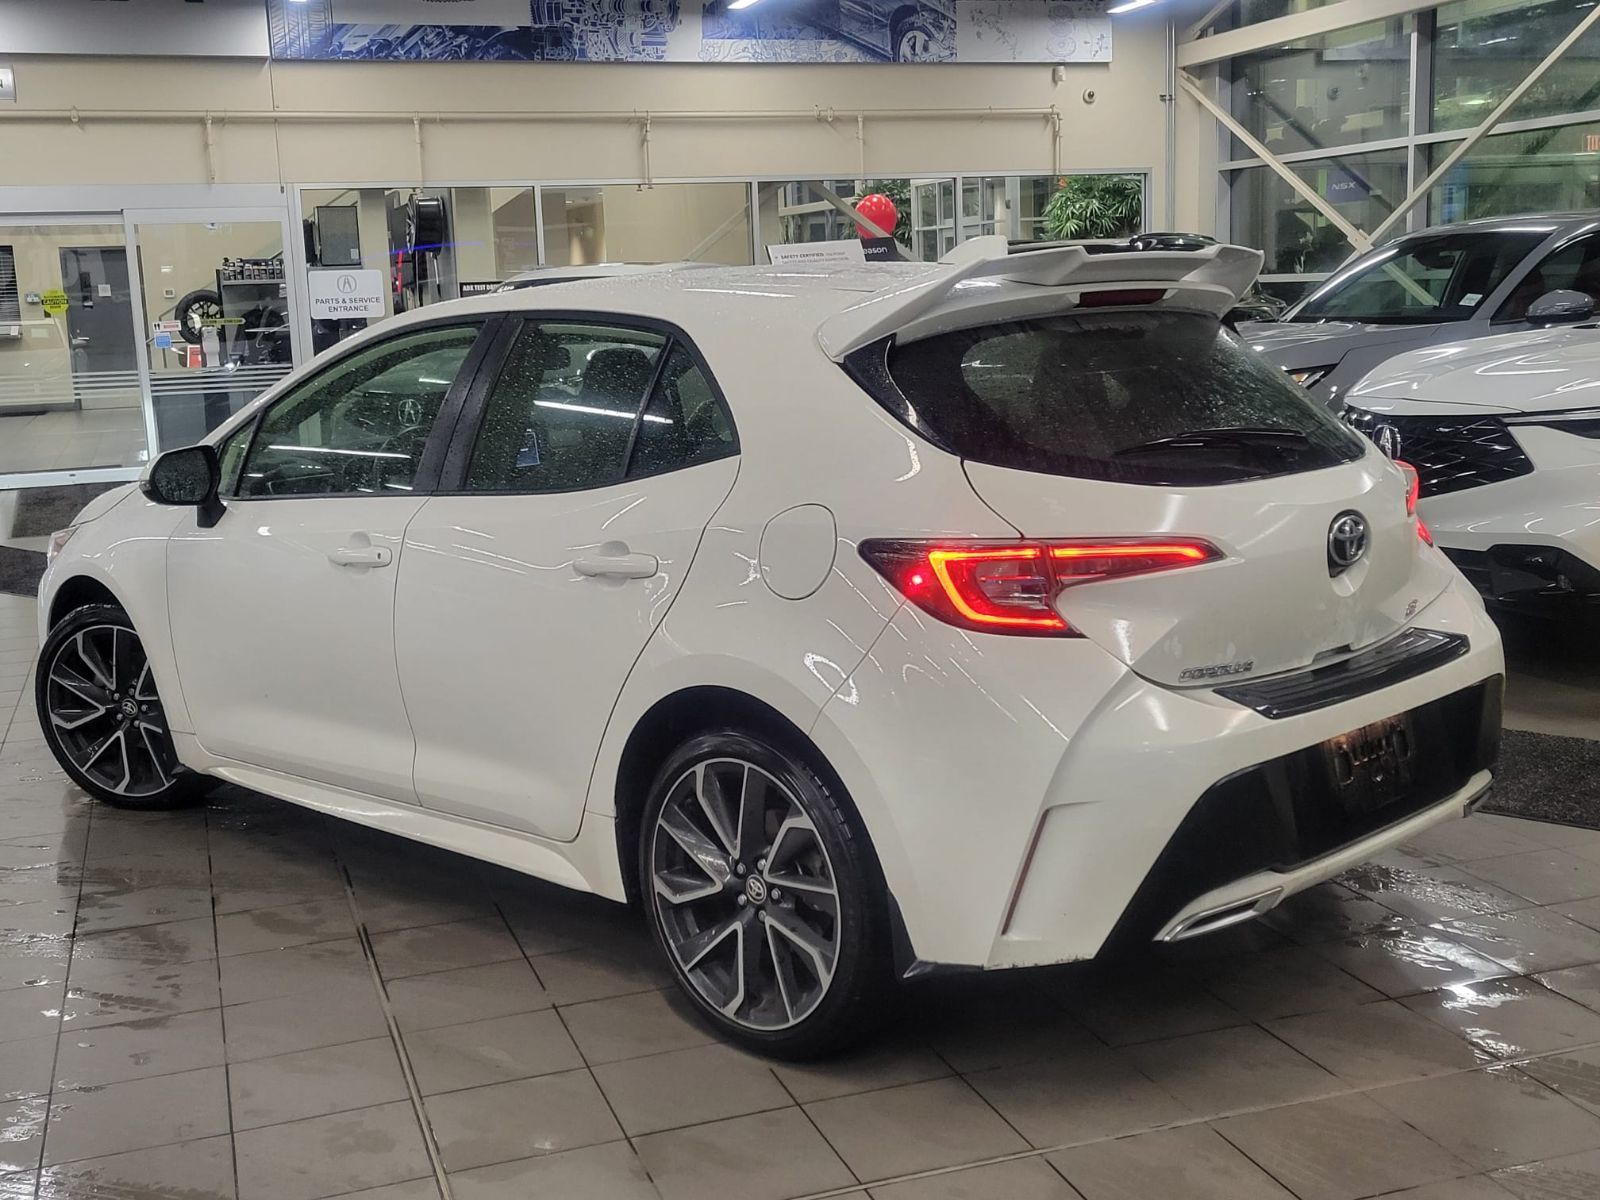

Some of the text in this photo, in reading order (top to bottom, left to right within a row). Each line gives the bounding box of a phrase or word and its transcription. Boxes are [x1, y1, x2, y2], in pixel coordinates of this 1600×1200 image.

[1331, 181, 1357, 190] NSX
[348, 296, 381, 304] SERVICE
[328, 305, 369, 313] ENTRANCE
